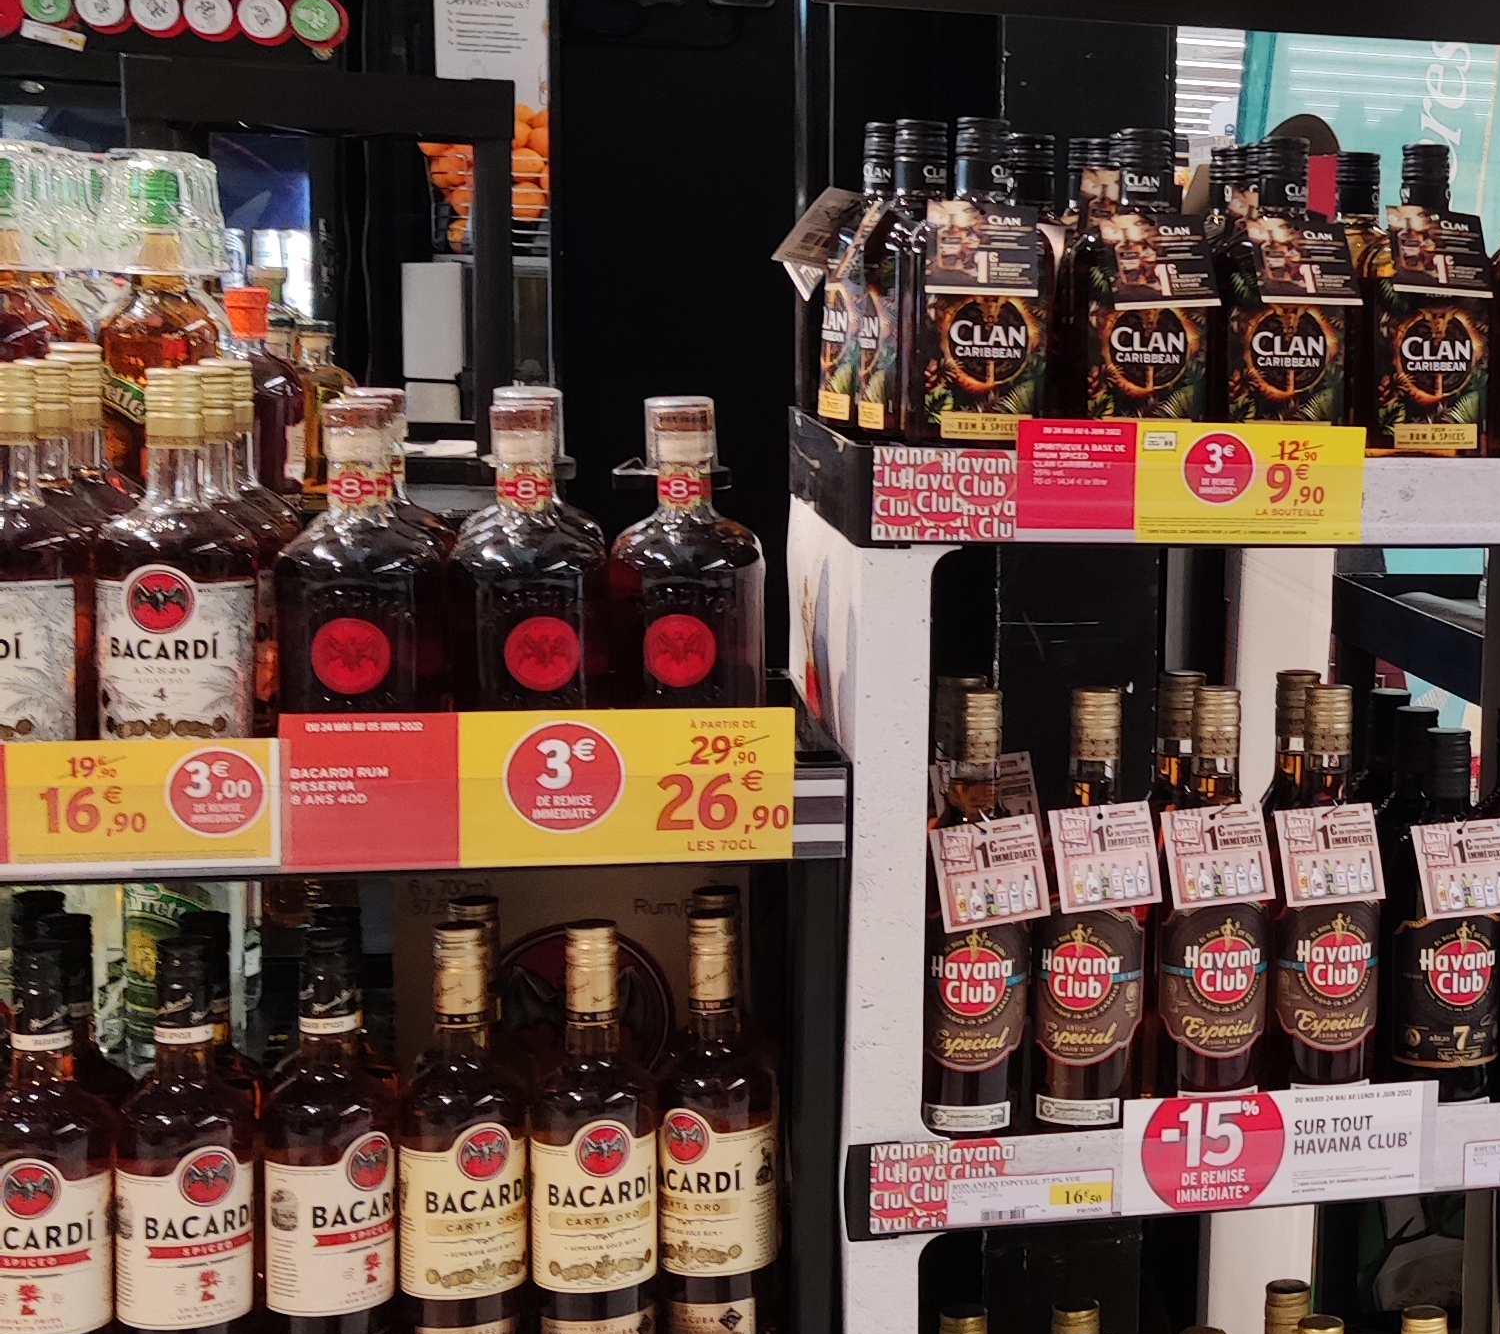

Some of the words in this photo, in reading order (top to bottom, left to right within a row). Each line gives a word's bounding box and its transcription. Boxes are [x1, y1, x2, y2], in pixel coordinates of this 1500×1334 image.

[950, 319, 1025, 347] CLAN
[1110, 326, 1185, 353] CLAN
[955, 344, 1021, 359] CARIBBEAN
[1115, 350, 1180, 365] CARIBBEAN
[1402, 337, 1471, 361] CLAN
[337, 475, 363, 500] 8
[516, 476, 537, 502] 8
[668, 474, 689, 500] 8
[1256, 508, 1267, 516] LA
[1272, 508, 1324, 517] BOUTEILLE
[110, 632, 222, 661] BACARDÍ
[536, 795, 551, 806] DE
[688, 840, 715, 851] LES
[1185, 946, 1261, 969] Havana
[1297, 939, 1371, 963] Havana
[1201, 970, 1248, 993] Club
[1313, 964, 1359, 986] Club
[1294, 1120, 1331, 1135] SUR
[1337, 1116, 1373, 1132] TOUT
[1294, 1136, 1362, 1156] HAVANA
[549, 1166, 652, 1207] BACARDÍ
[1180, 1170, 1197, 1186] DE
[1201, 1169, 1245, 1185] REMISE
[425, 1178, 526, 1214] BACARD
